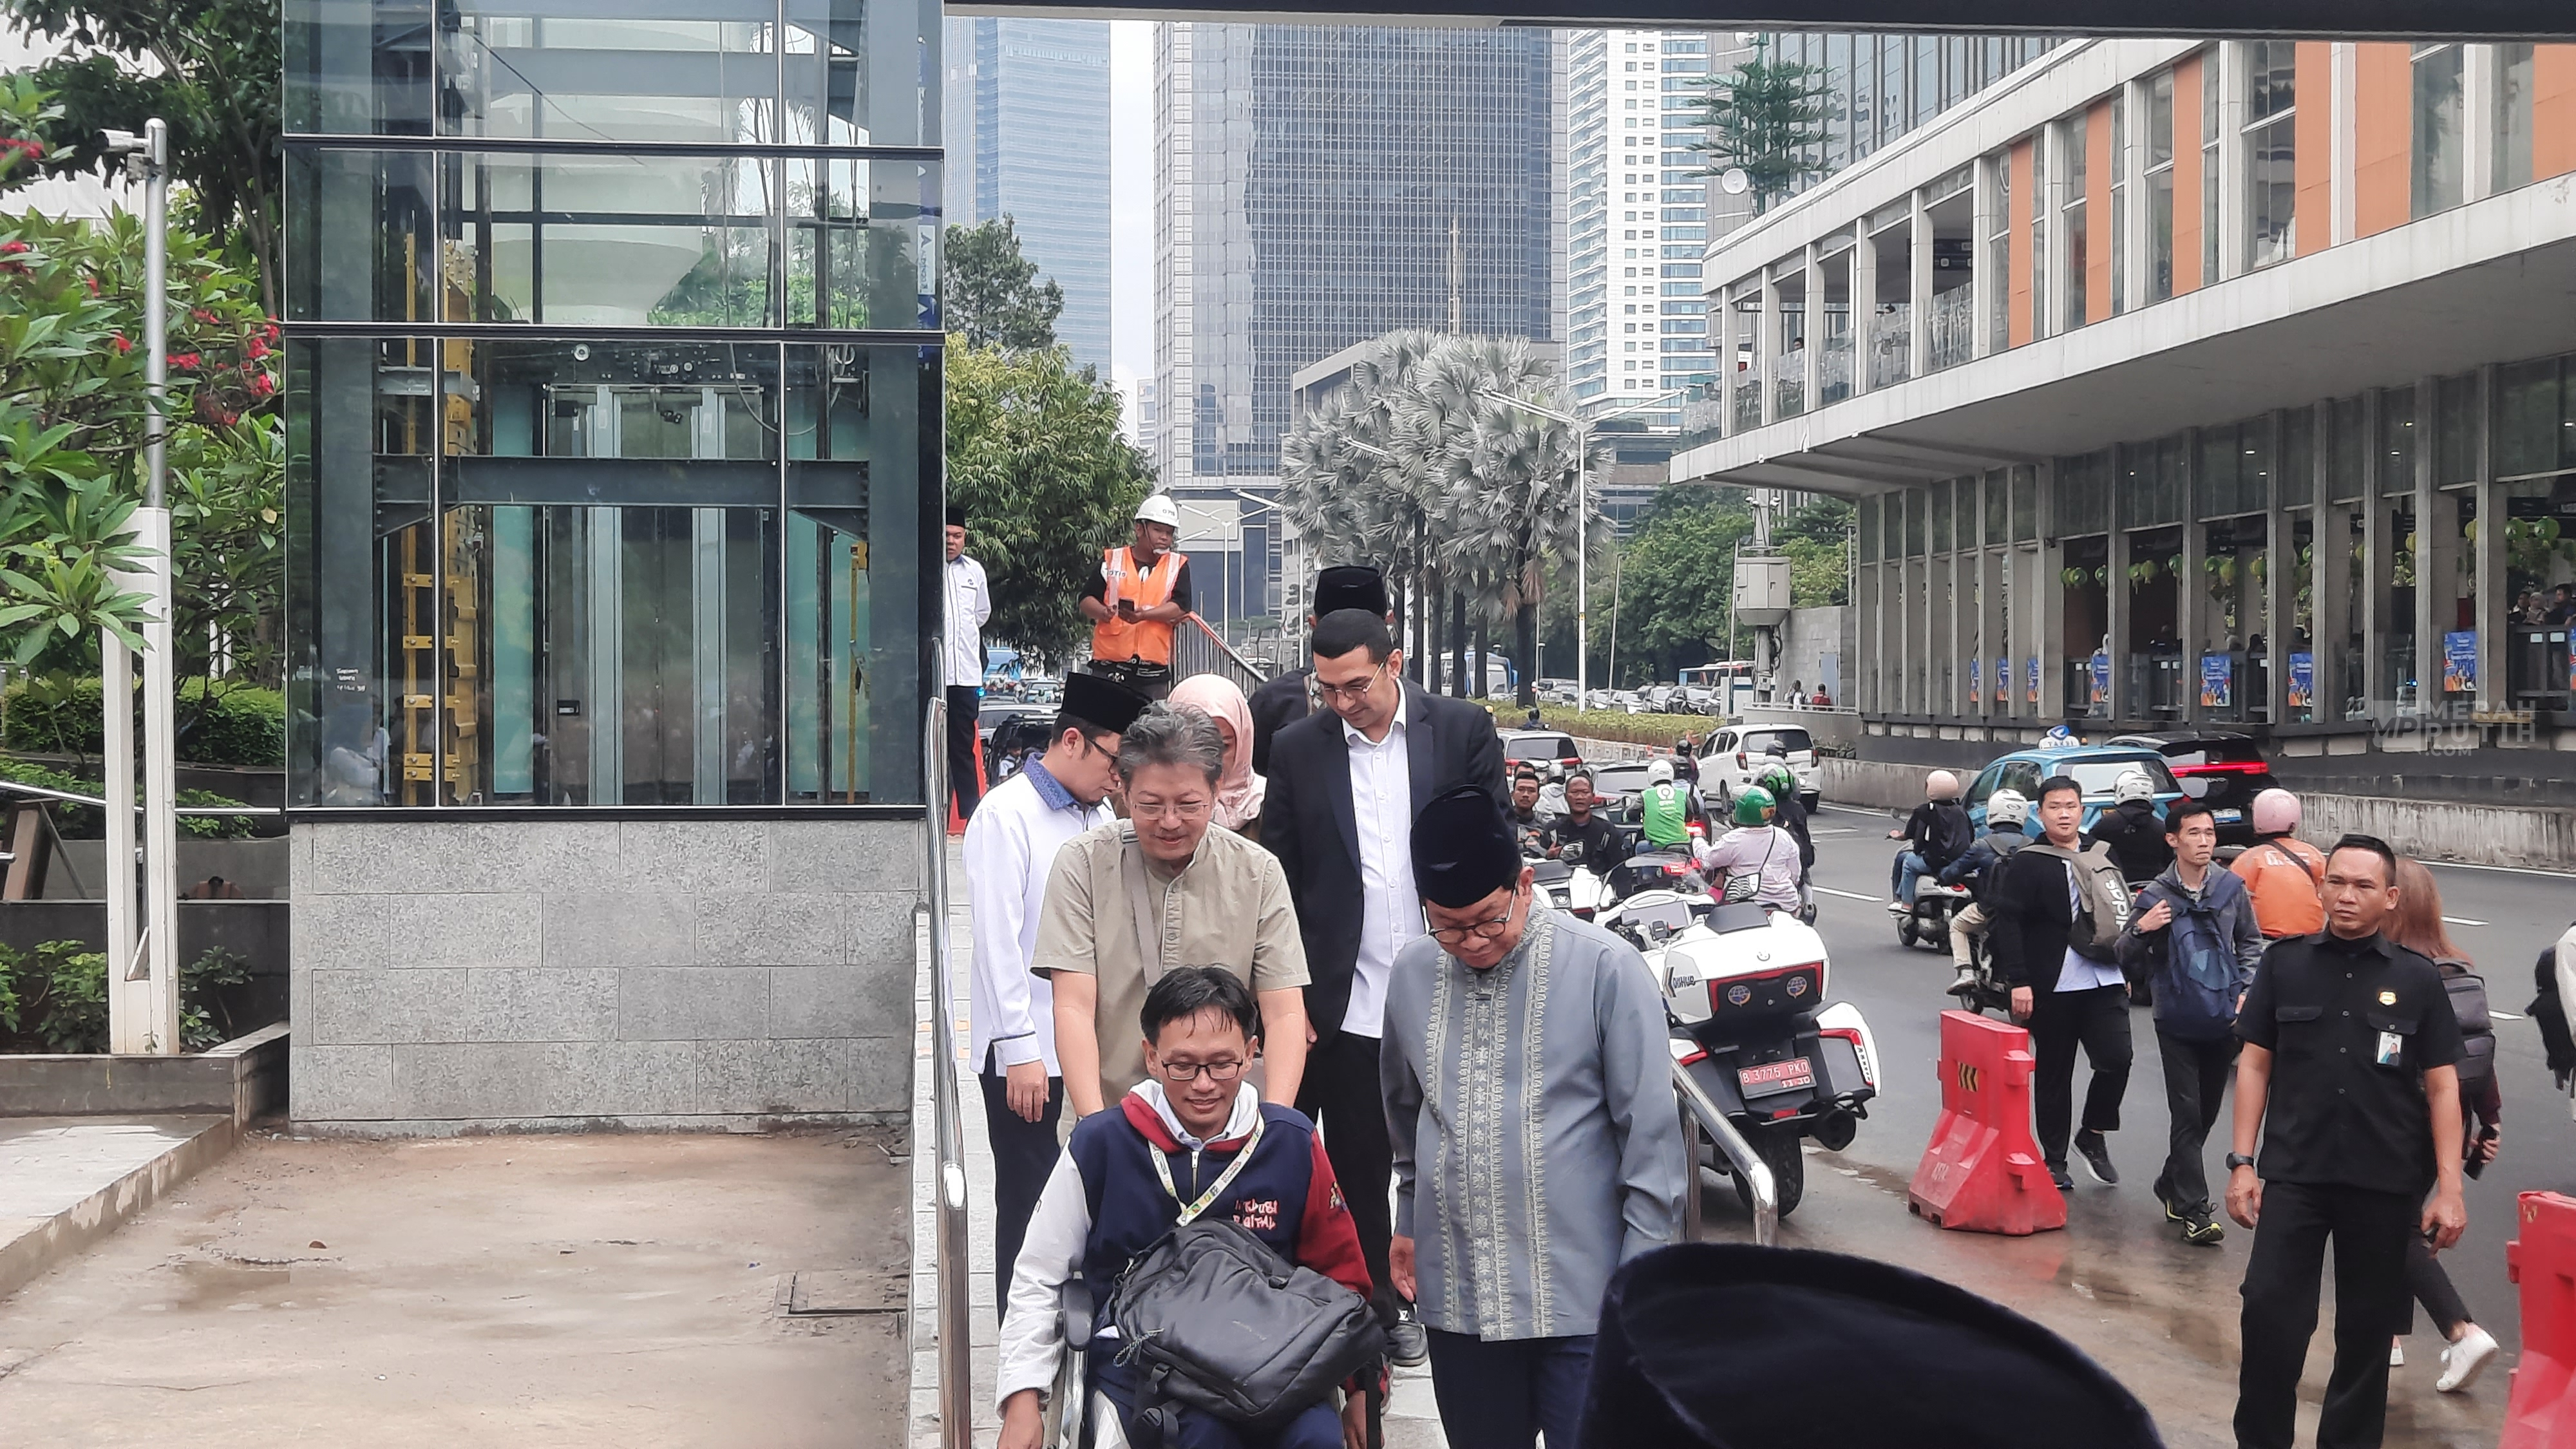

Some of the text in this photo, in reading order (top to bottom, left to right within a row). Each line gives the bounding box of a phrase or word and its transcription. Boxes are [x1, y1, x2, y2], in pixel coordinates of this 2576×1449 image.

[1742, 1072, 1750, 1083] B
[1753, 1066, 1781, 1081] 3775
[1233, 1214, 1276, 1230] DGITAL
